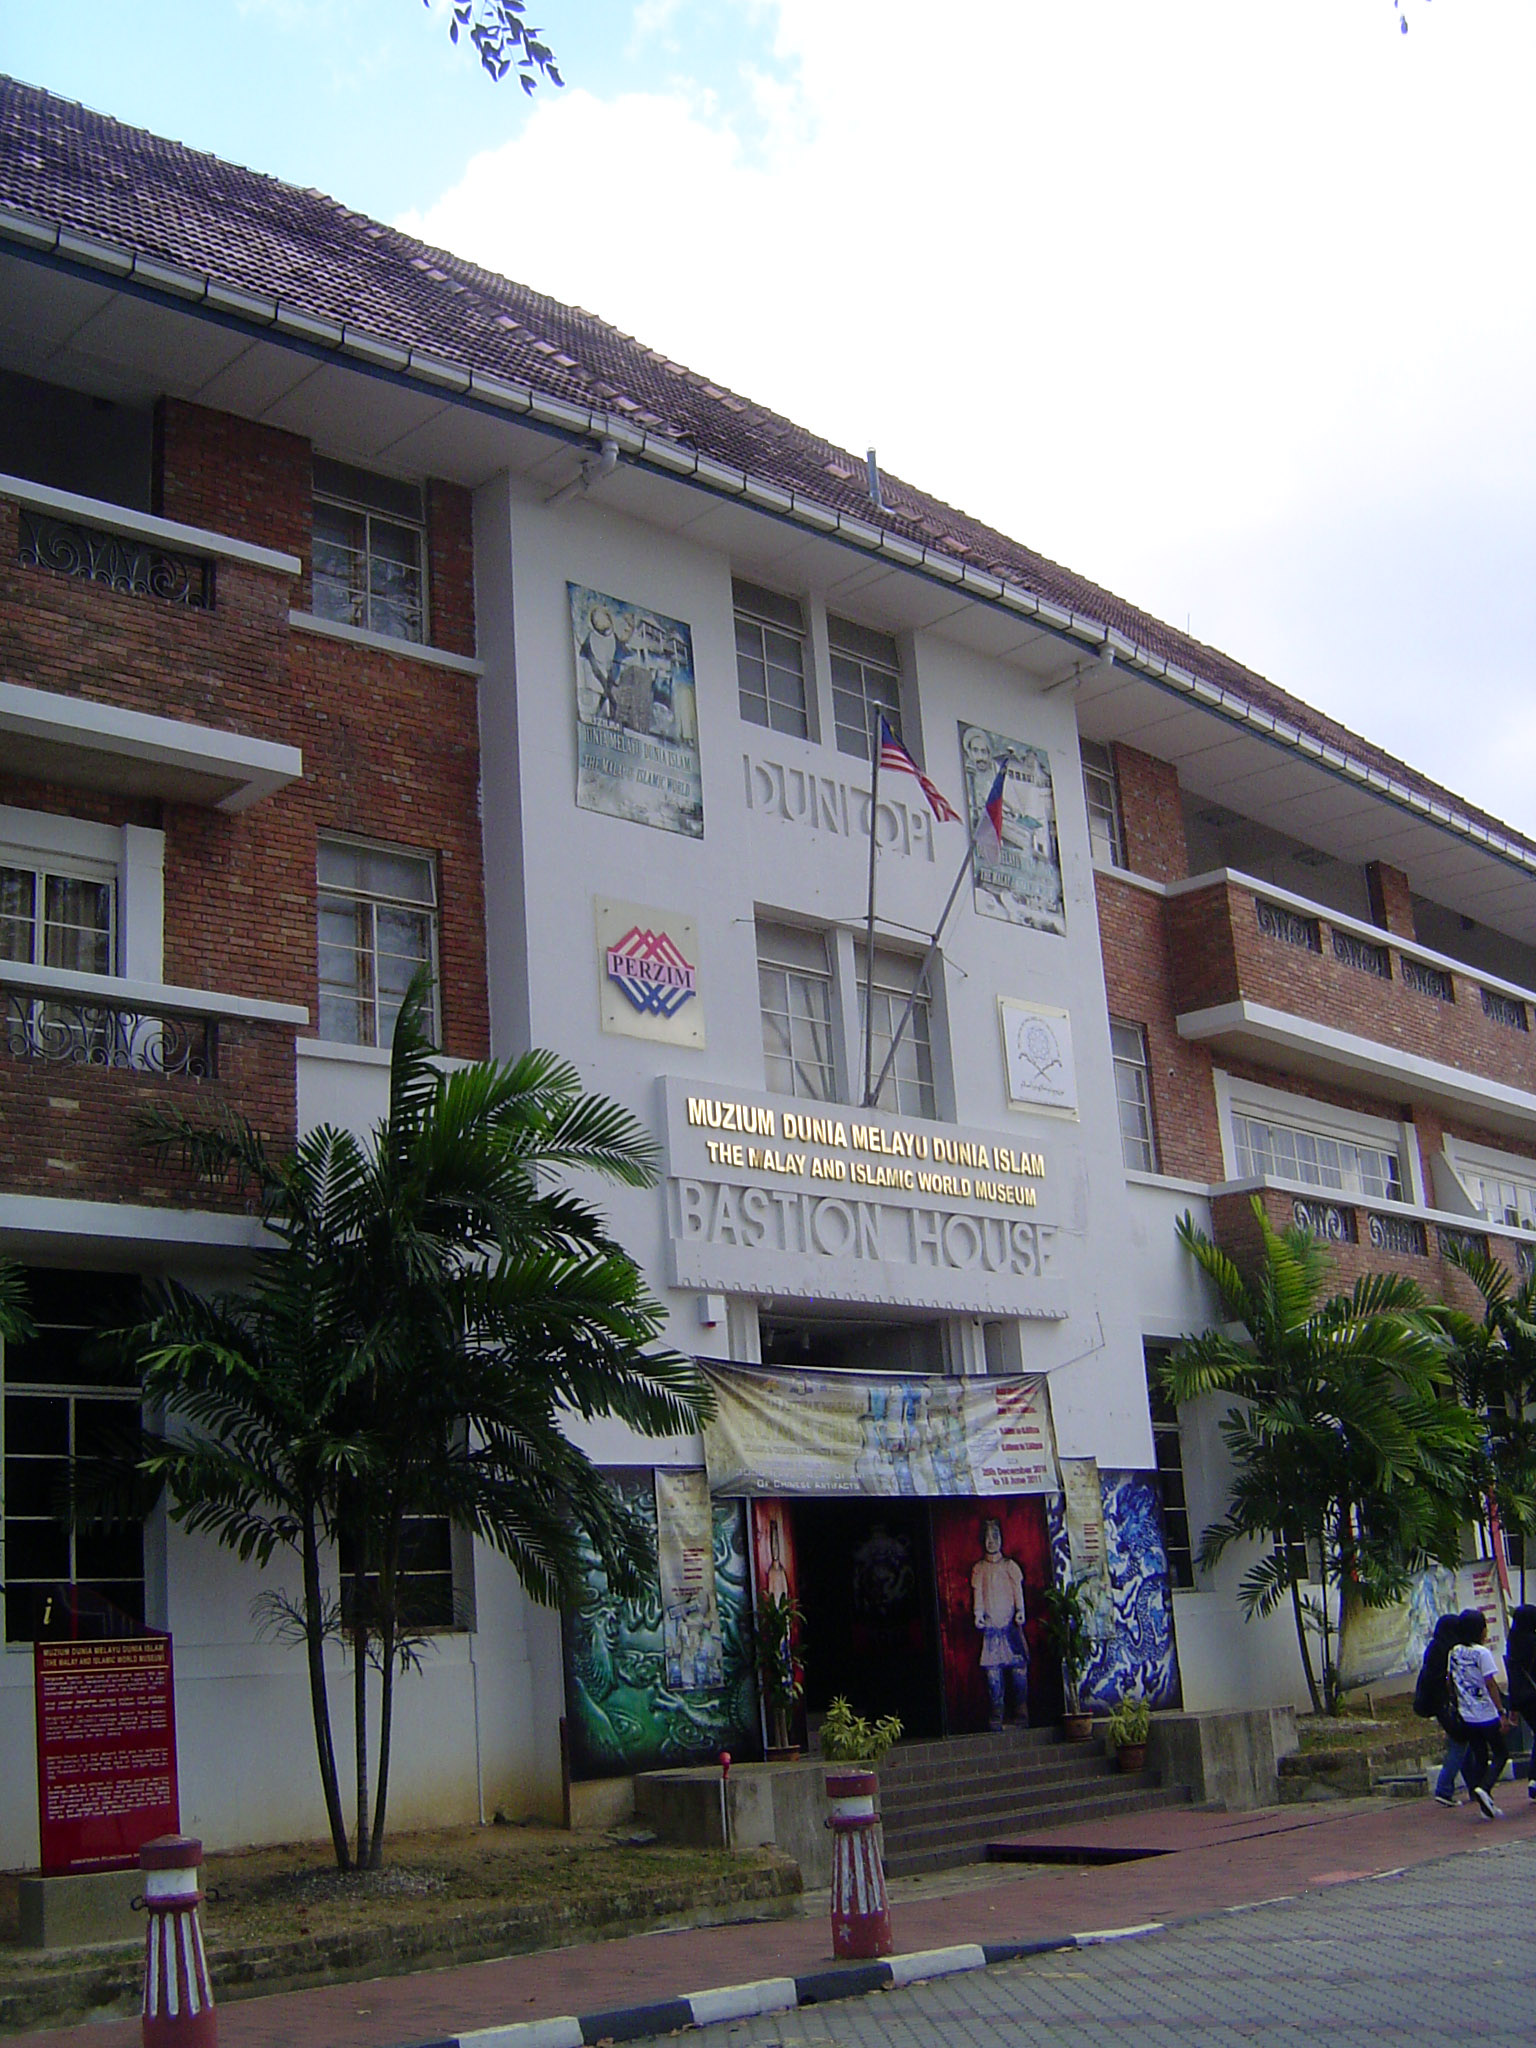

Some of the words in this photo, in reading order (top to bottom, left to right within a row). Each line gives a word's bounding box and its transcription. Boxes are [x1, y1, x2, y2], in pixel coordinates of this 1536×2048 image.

[612, 953, 693, 988] PERZIM
[687, 1097, 775, 1136] MUZIUM
[783, 1113, 847, 1149] DUNIA
[851, 1124, 928, 1158] MELAYU
[933, 1137, 989, 1170] DUNIA
[993, 1148, 1045, 1178] ISLAM
[706, 1141, 744, 1168] THE
[748, 1147, 806, 1176] MALAY
[811, 1157, 846, 1182] AND
[850, 1163, 914, 1190] ISLAMIC
[918, 1172, 971, 1198] WORLD
[975, 1180, 1037, 1207] MUSEUM
[679, 1179, 881, 1260] BASTION
[911, 1208, 1062, 1278] HOUSE
[94, 1646, 120, 1654] MELAYU
